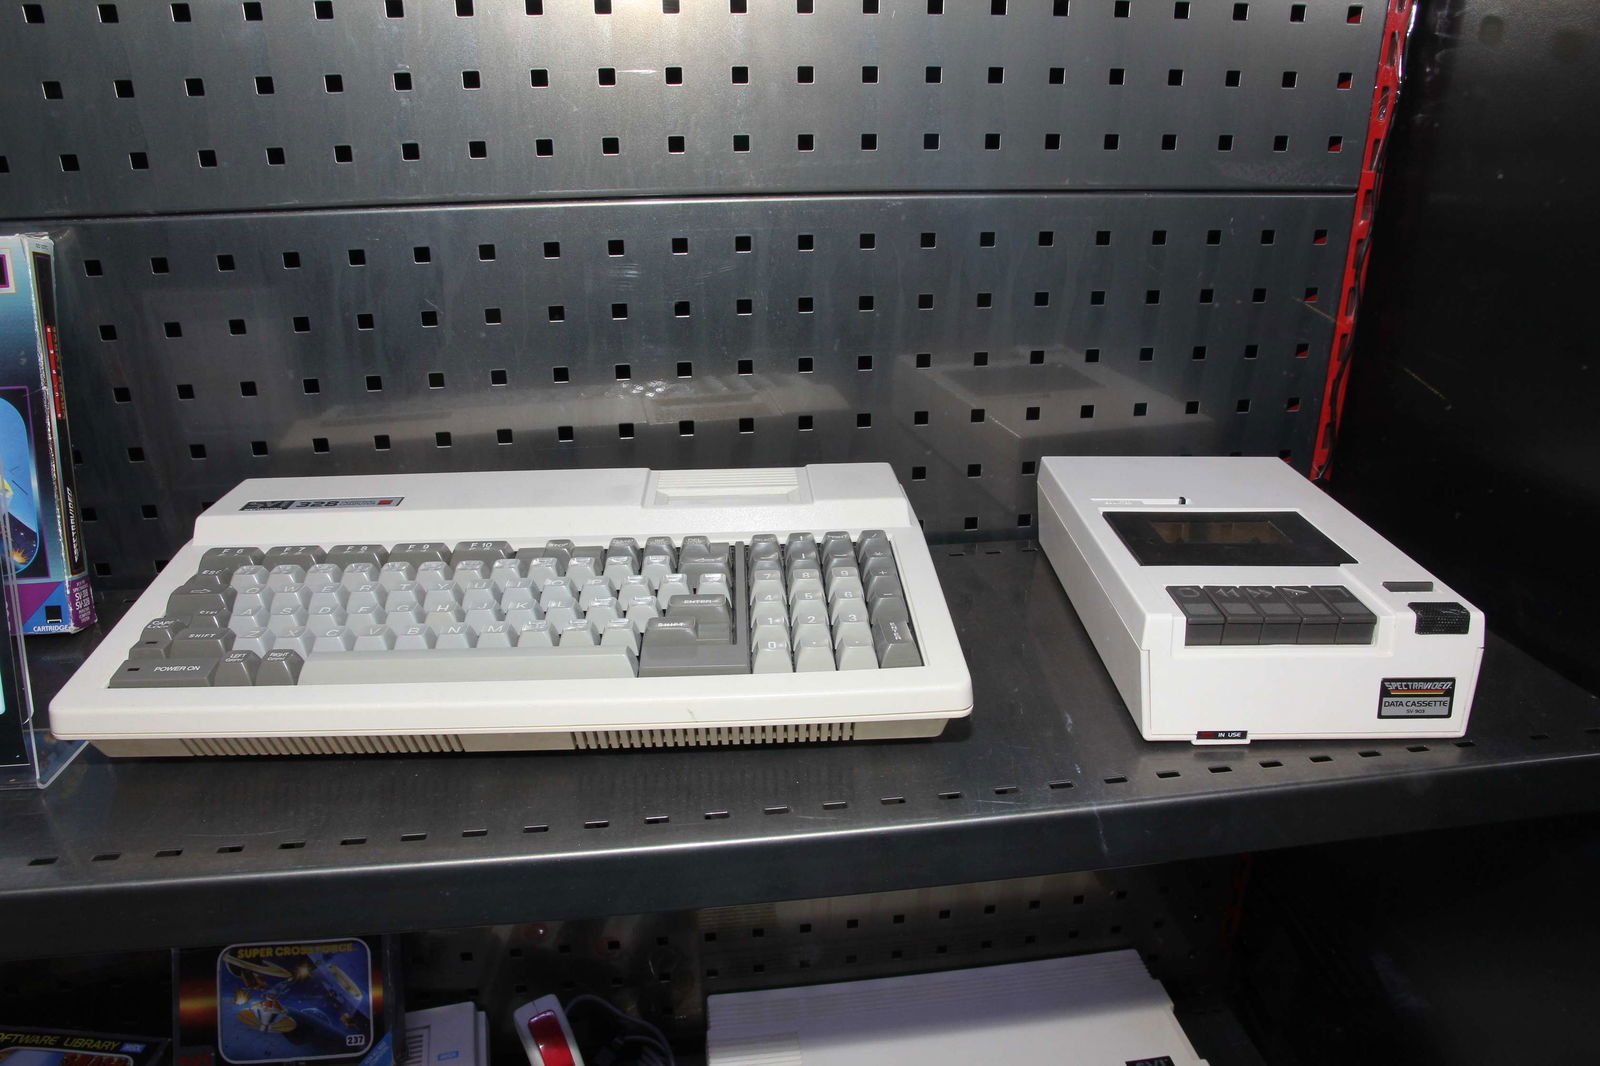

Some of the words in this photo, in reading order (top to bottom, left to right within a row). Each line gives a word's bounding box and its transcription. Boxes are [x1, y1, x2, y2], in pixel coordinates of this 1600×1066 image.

[804, 592, 813, 600] 5
[807, 616, 816, 624] 2
[848, 614, 857, 622] 3
[33, 624, 69, 632] CARTRIDGE
[1384, 682, 1452, 690] SPECTRAVIDEO
[1384, 700, 1404, 708] DATA
[1406, 700, 1448, 708] CASSETTE
[238, 946, 273, 958] SUPER
[348, 1036, 364, 1044] 237
[64, 1038, 120, 1051] LIBRARY
